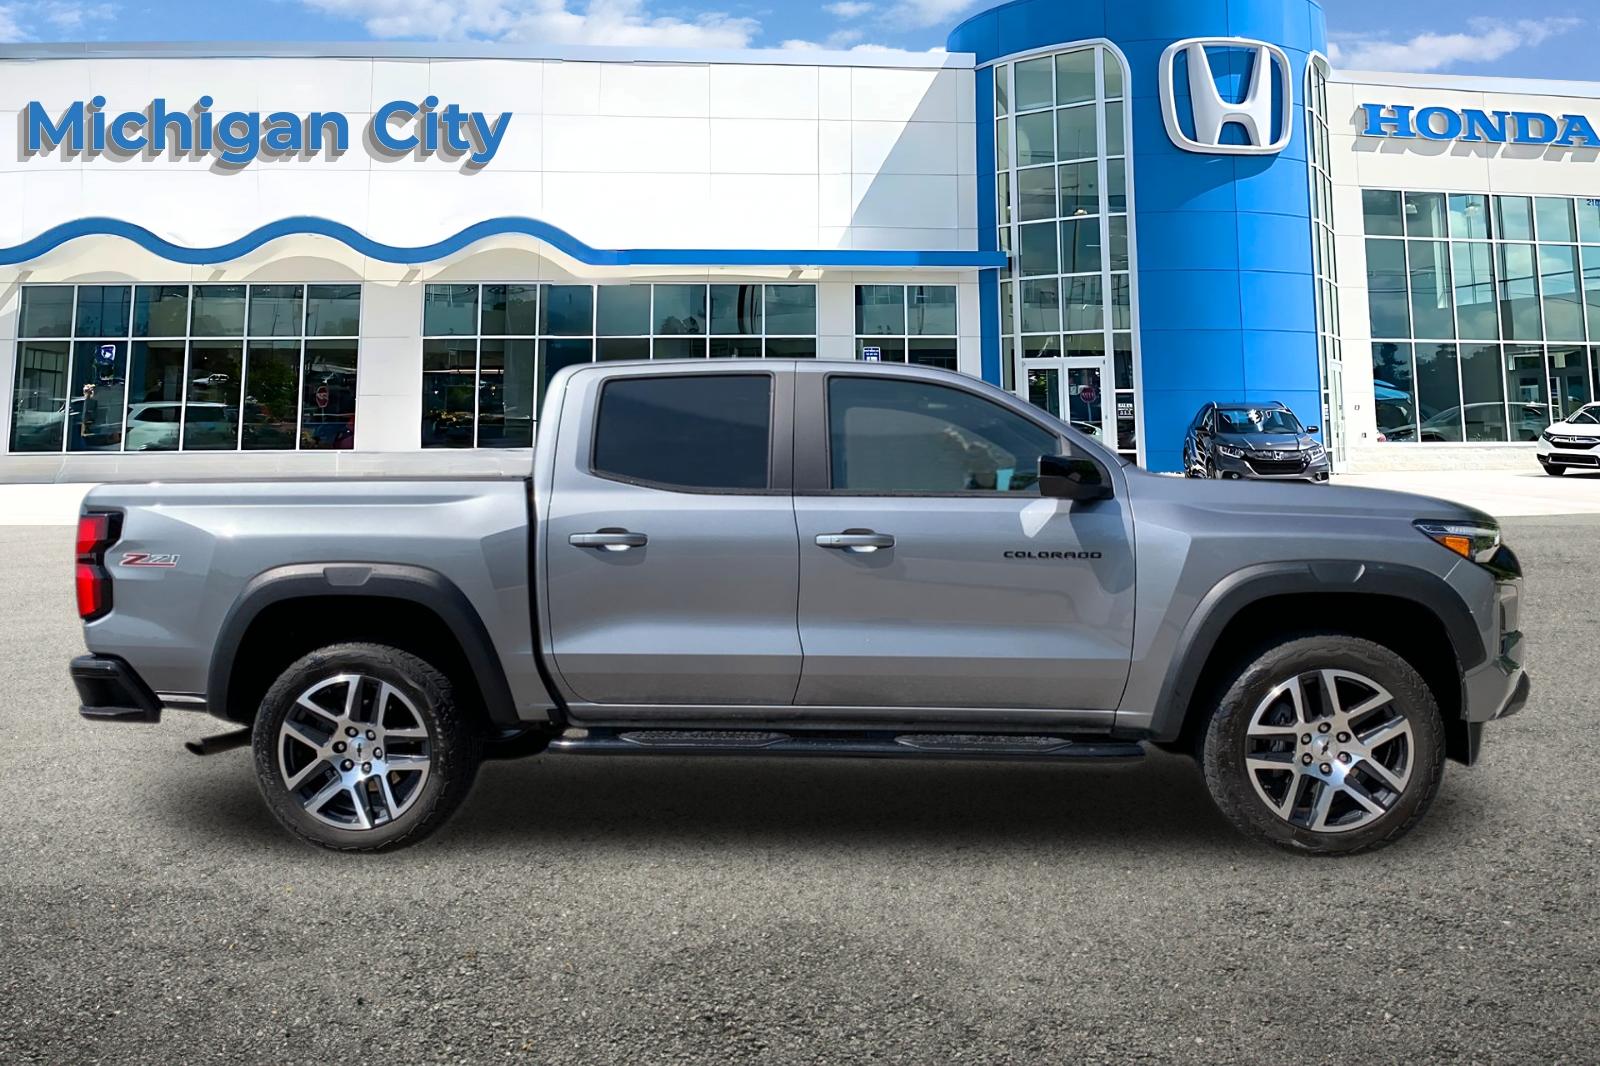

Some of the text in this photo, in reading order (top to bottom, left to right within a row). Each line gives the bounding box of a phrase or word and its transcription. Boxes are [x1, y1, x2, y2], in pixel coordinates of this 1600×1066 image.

[27, 95, 513, 165] Michigan City
[1361, 102, 1600, 148] HONDA
[119, 552, 180, 567] Z71
[1003, 551, 1102, 559] COLORADO
